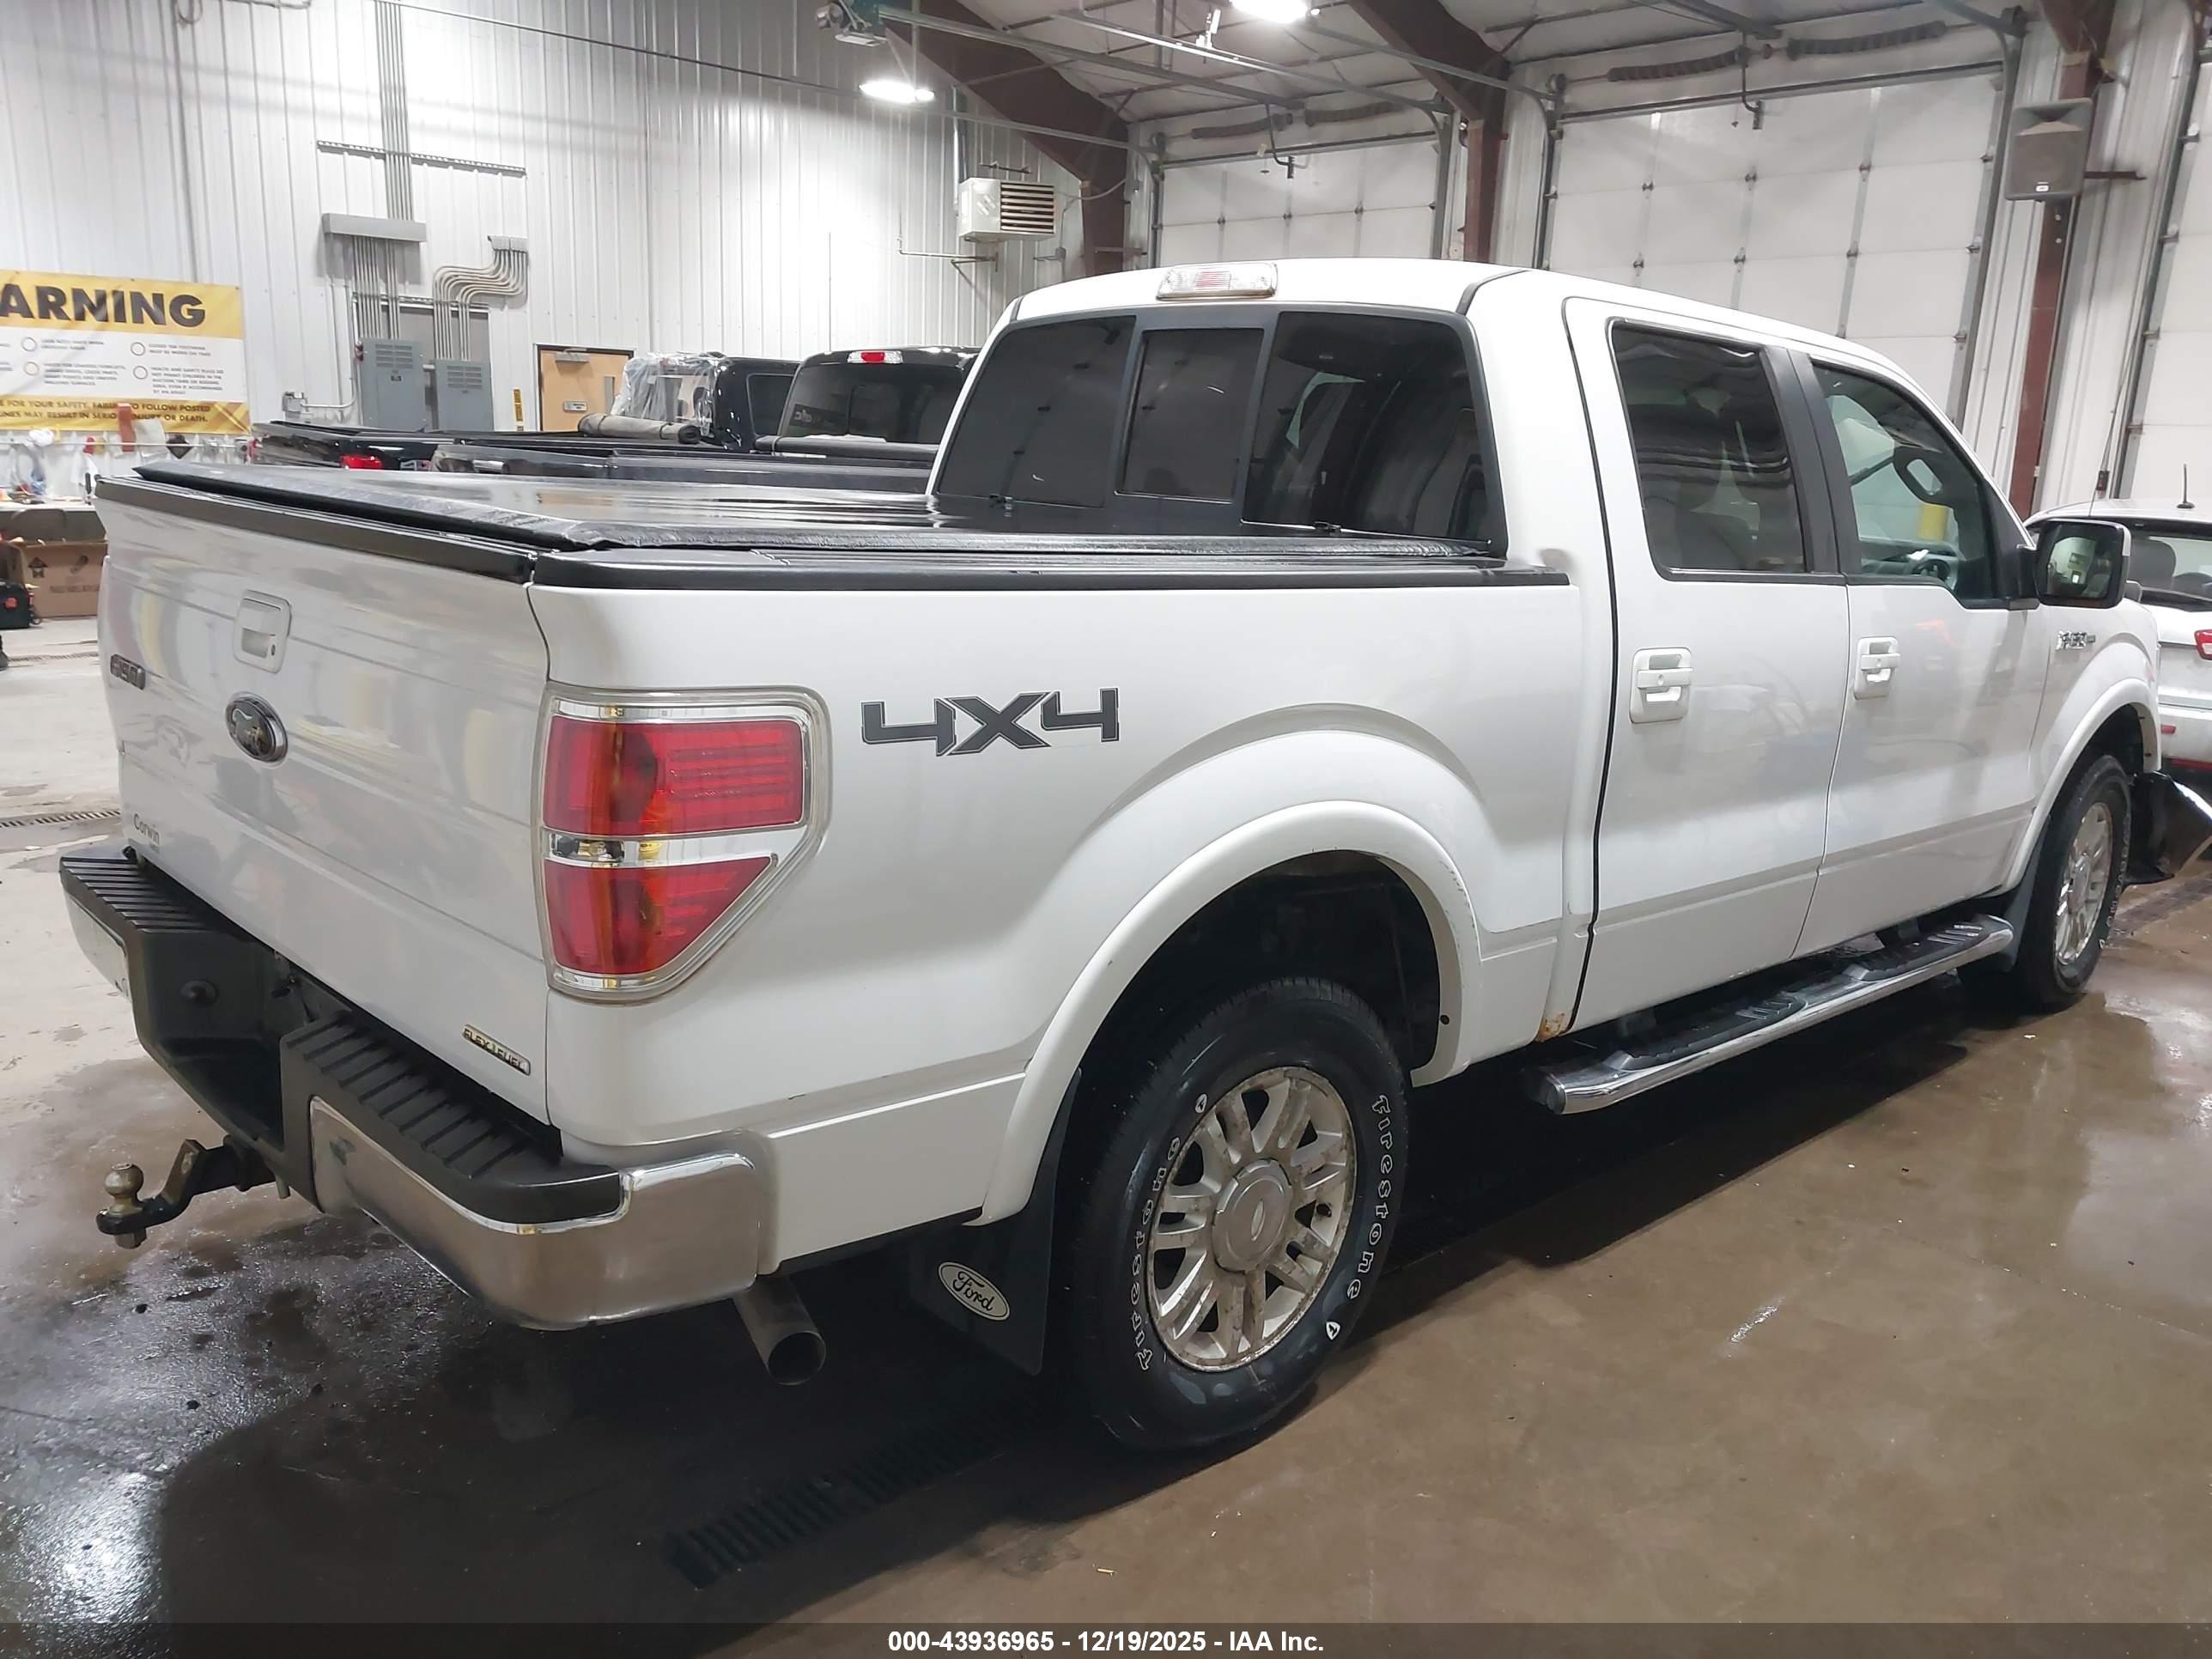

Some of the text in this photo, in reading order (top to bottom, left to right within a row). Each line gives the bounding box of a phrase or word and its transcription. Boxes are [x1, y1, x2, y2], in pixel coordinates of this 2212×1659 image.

[142, 404, 178, 412] FOLLOW
[133, 812, 160, 846] Corwin
[1346, 1095, 1394, 1300] Firestone
[1130, 1137, 1182, 1371] Firestone
[952, 1270, 995, 1311] Ford
